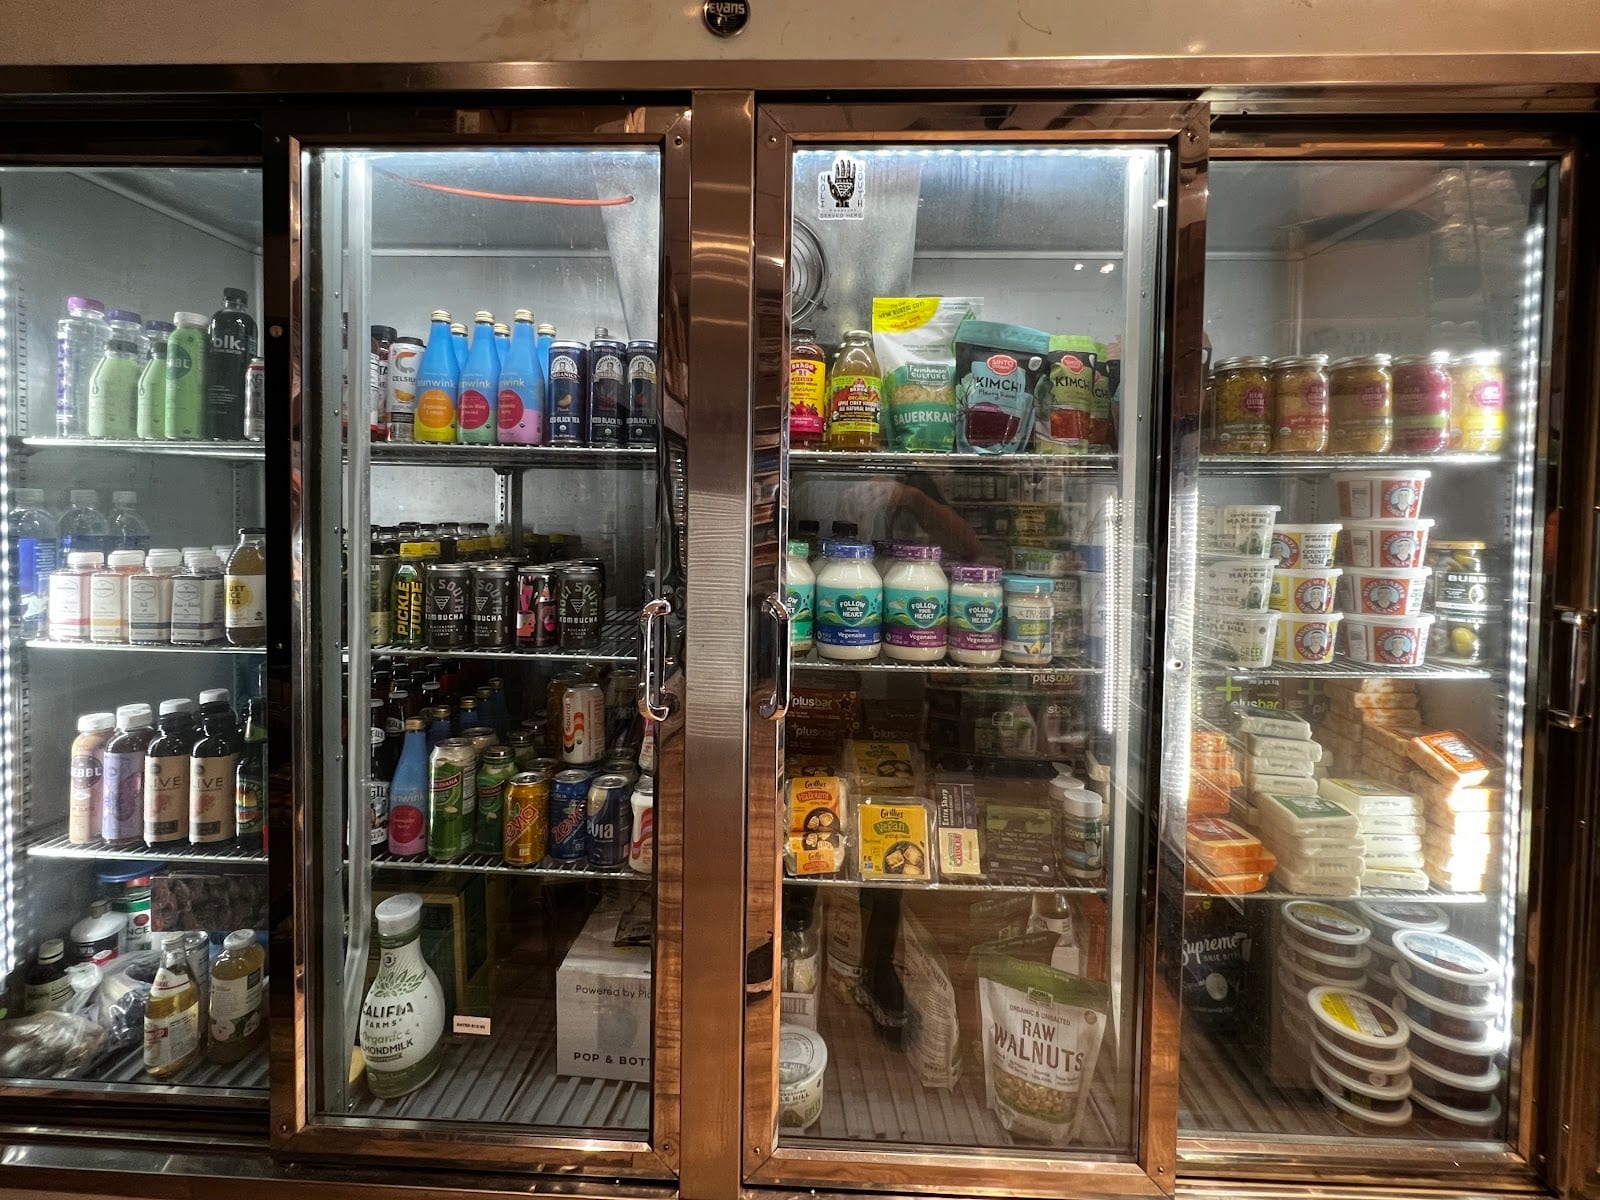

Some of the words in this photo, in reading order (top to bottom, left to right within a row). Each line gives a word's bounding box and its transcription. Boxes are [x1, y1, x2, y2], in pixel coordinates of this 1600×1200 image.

[503, 378, 526, 388] wink
[976, 376, 1022, 392] KIMCHI
[438, 579, 464, 613] SOUTH
[560, 585, 572, 617] NOLI
[575, 582, 598, 617] SOUTH
[397, 581, 410, 636] PICKLE
[411, 581, 423, 635] JUICE
[839, 600, 866, 609] FOLLOW
[911, 602, 937, 610] FOLLOW
[968, 606, 994, 614] FOLLOW
[425, 613, 464, 621] OMBUCHA
[473, 614, 503, 622] BUCHA
[791, 695, 833, 707] plusbar
[150, 776, 181, 788] IVE
[193, 776, 224, 788] IVE
[575, 983, 620, 998] Powered
[622, 988, 636, 999] by
[1022, 1018, 1056, 1042] RAW
[994, 1021, 1085, 1073] WALNUTS
[573, 1051, 600, 1062] POP
[605, 1054, 614, 1064] &
